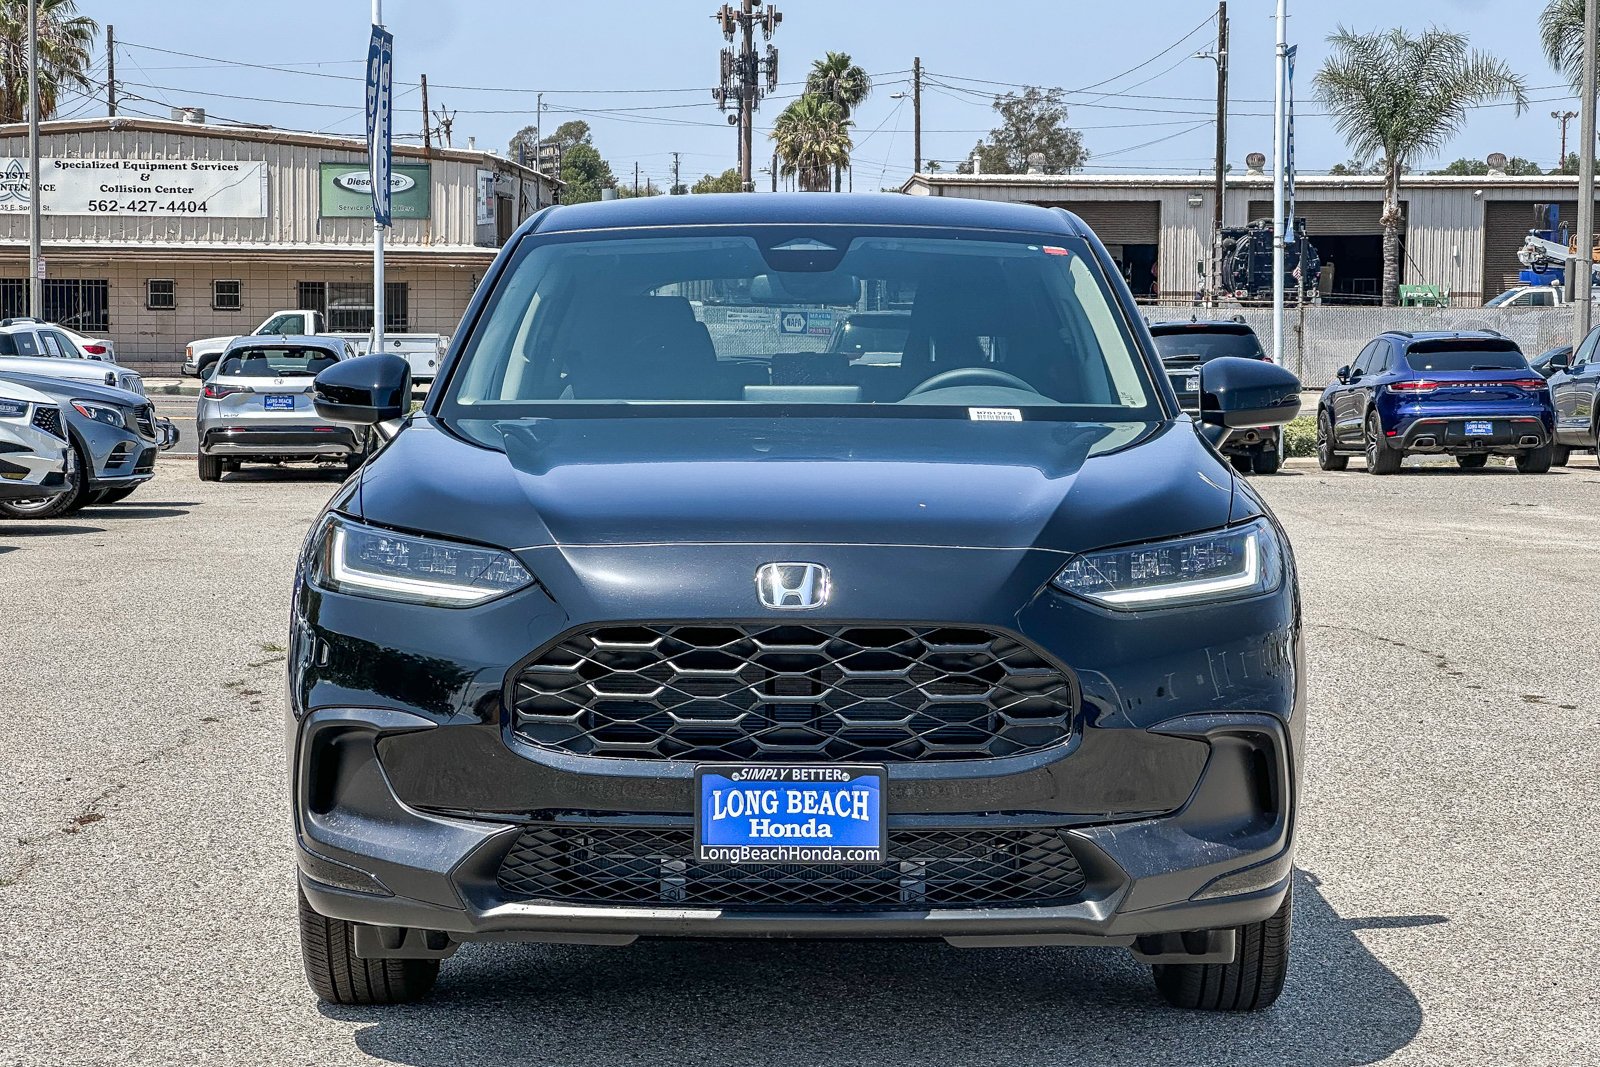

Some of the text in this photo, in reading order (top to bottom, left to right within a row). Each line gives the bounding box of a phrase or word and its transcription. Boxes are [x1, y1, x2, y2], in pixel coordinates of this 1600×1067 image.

[54, 160, 239, 171] Specialized Equipment Services
[0, 171, 30, 179] SYSTE
[140, 173, 150, 182] &
[0, 183, 56, 191] NTENCE
[99, 184, 195, 194] Collision Center
[87, 199, 208, 214] 562-427-4404
[786, 317, 802, 327] NAPA
[739, 768, 843, 781] SIMPLY BETTER
[712, 790, 870, 821] LONG BEACH
[749, 818, 833, 838] Honda
[700, 846, 880, 863] LongBeachHonda.com
